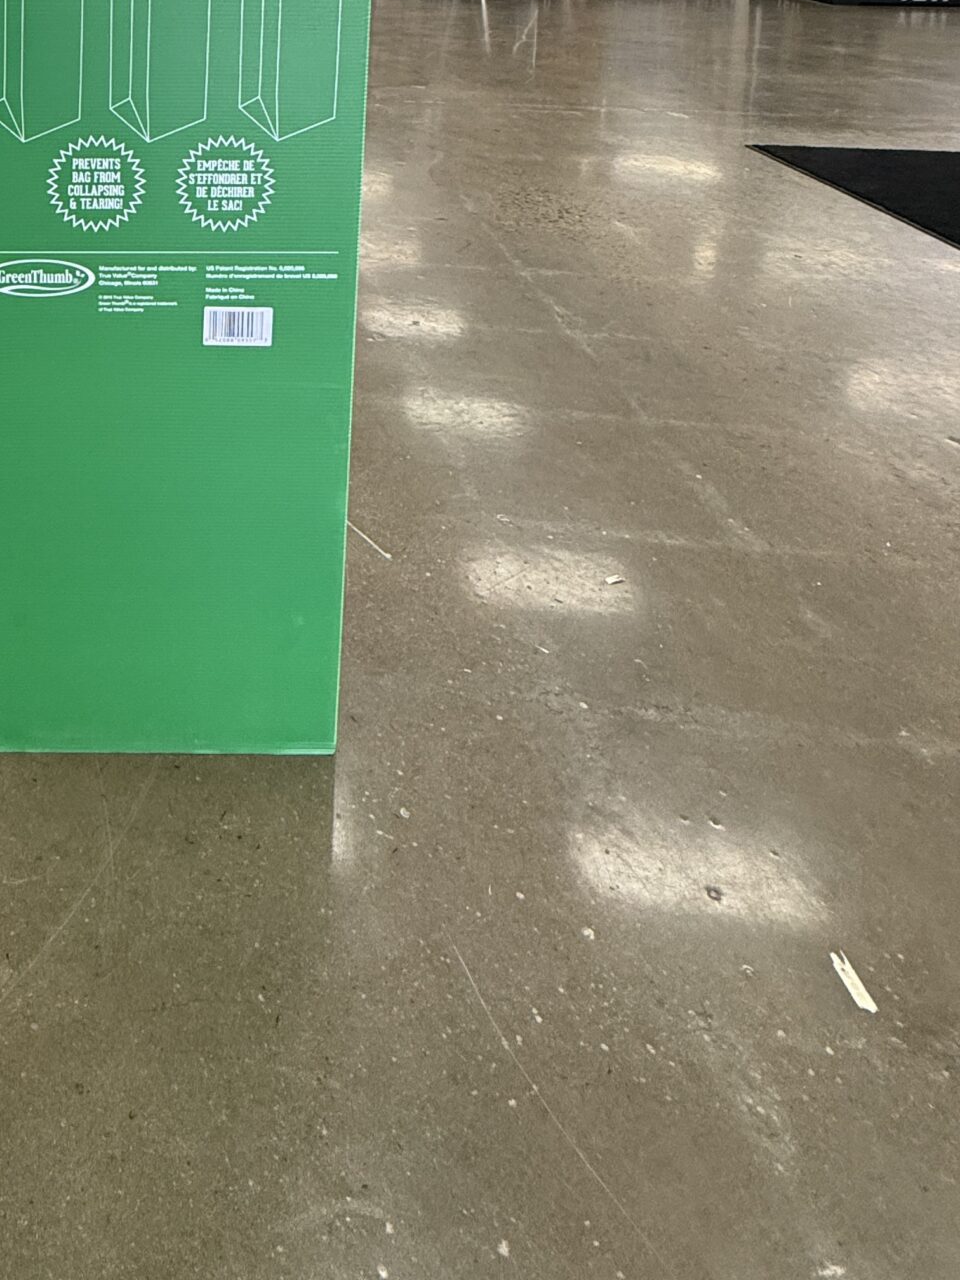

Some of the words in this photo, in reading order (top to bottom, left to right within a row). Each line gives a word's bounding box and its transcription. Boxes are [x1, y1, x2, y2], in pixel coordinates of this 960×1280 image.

[72, 157, 120, 169] PREVENTS
[242, 159, 255, 171] DE
[71, 171, 91, 183] BAG
[93, 171, 120, 183] FROM
[250, 172, 263, 184] ET
[67, 184, 124, 196] COLLAPSING
[195, 186, 208, 198] DE
[69, 197, 76, 209] &
[79, 197, 124, 210] TEARING!
[207, 199, 219, 211] LE
[221, 199, 242, 210] SAC!
